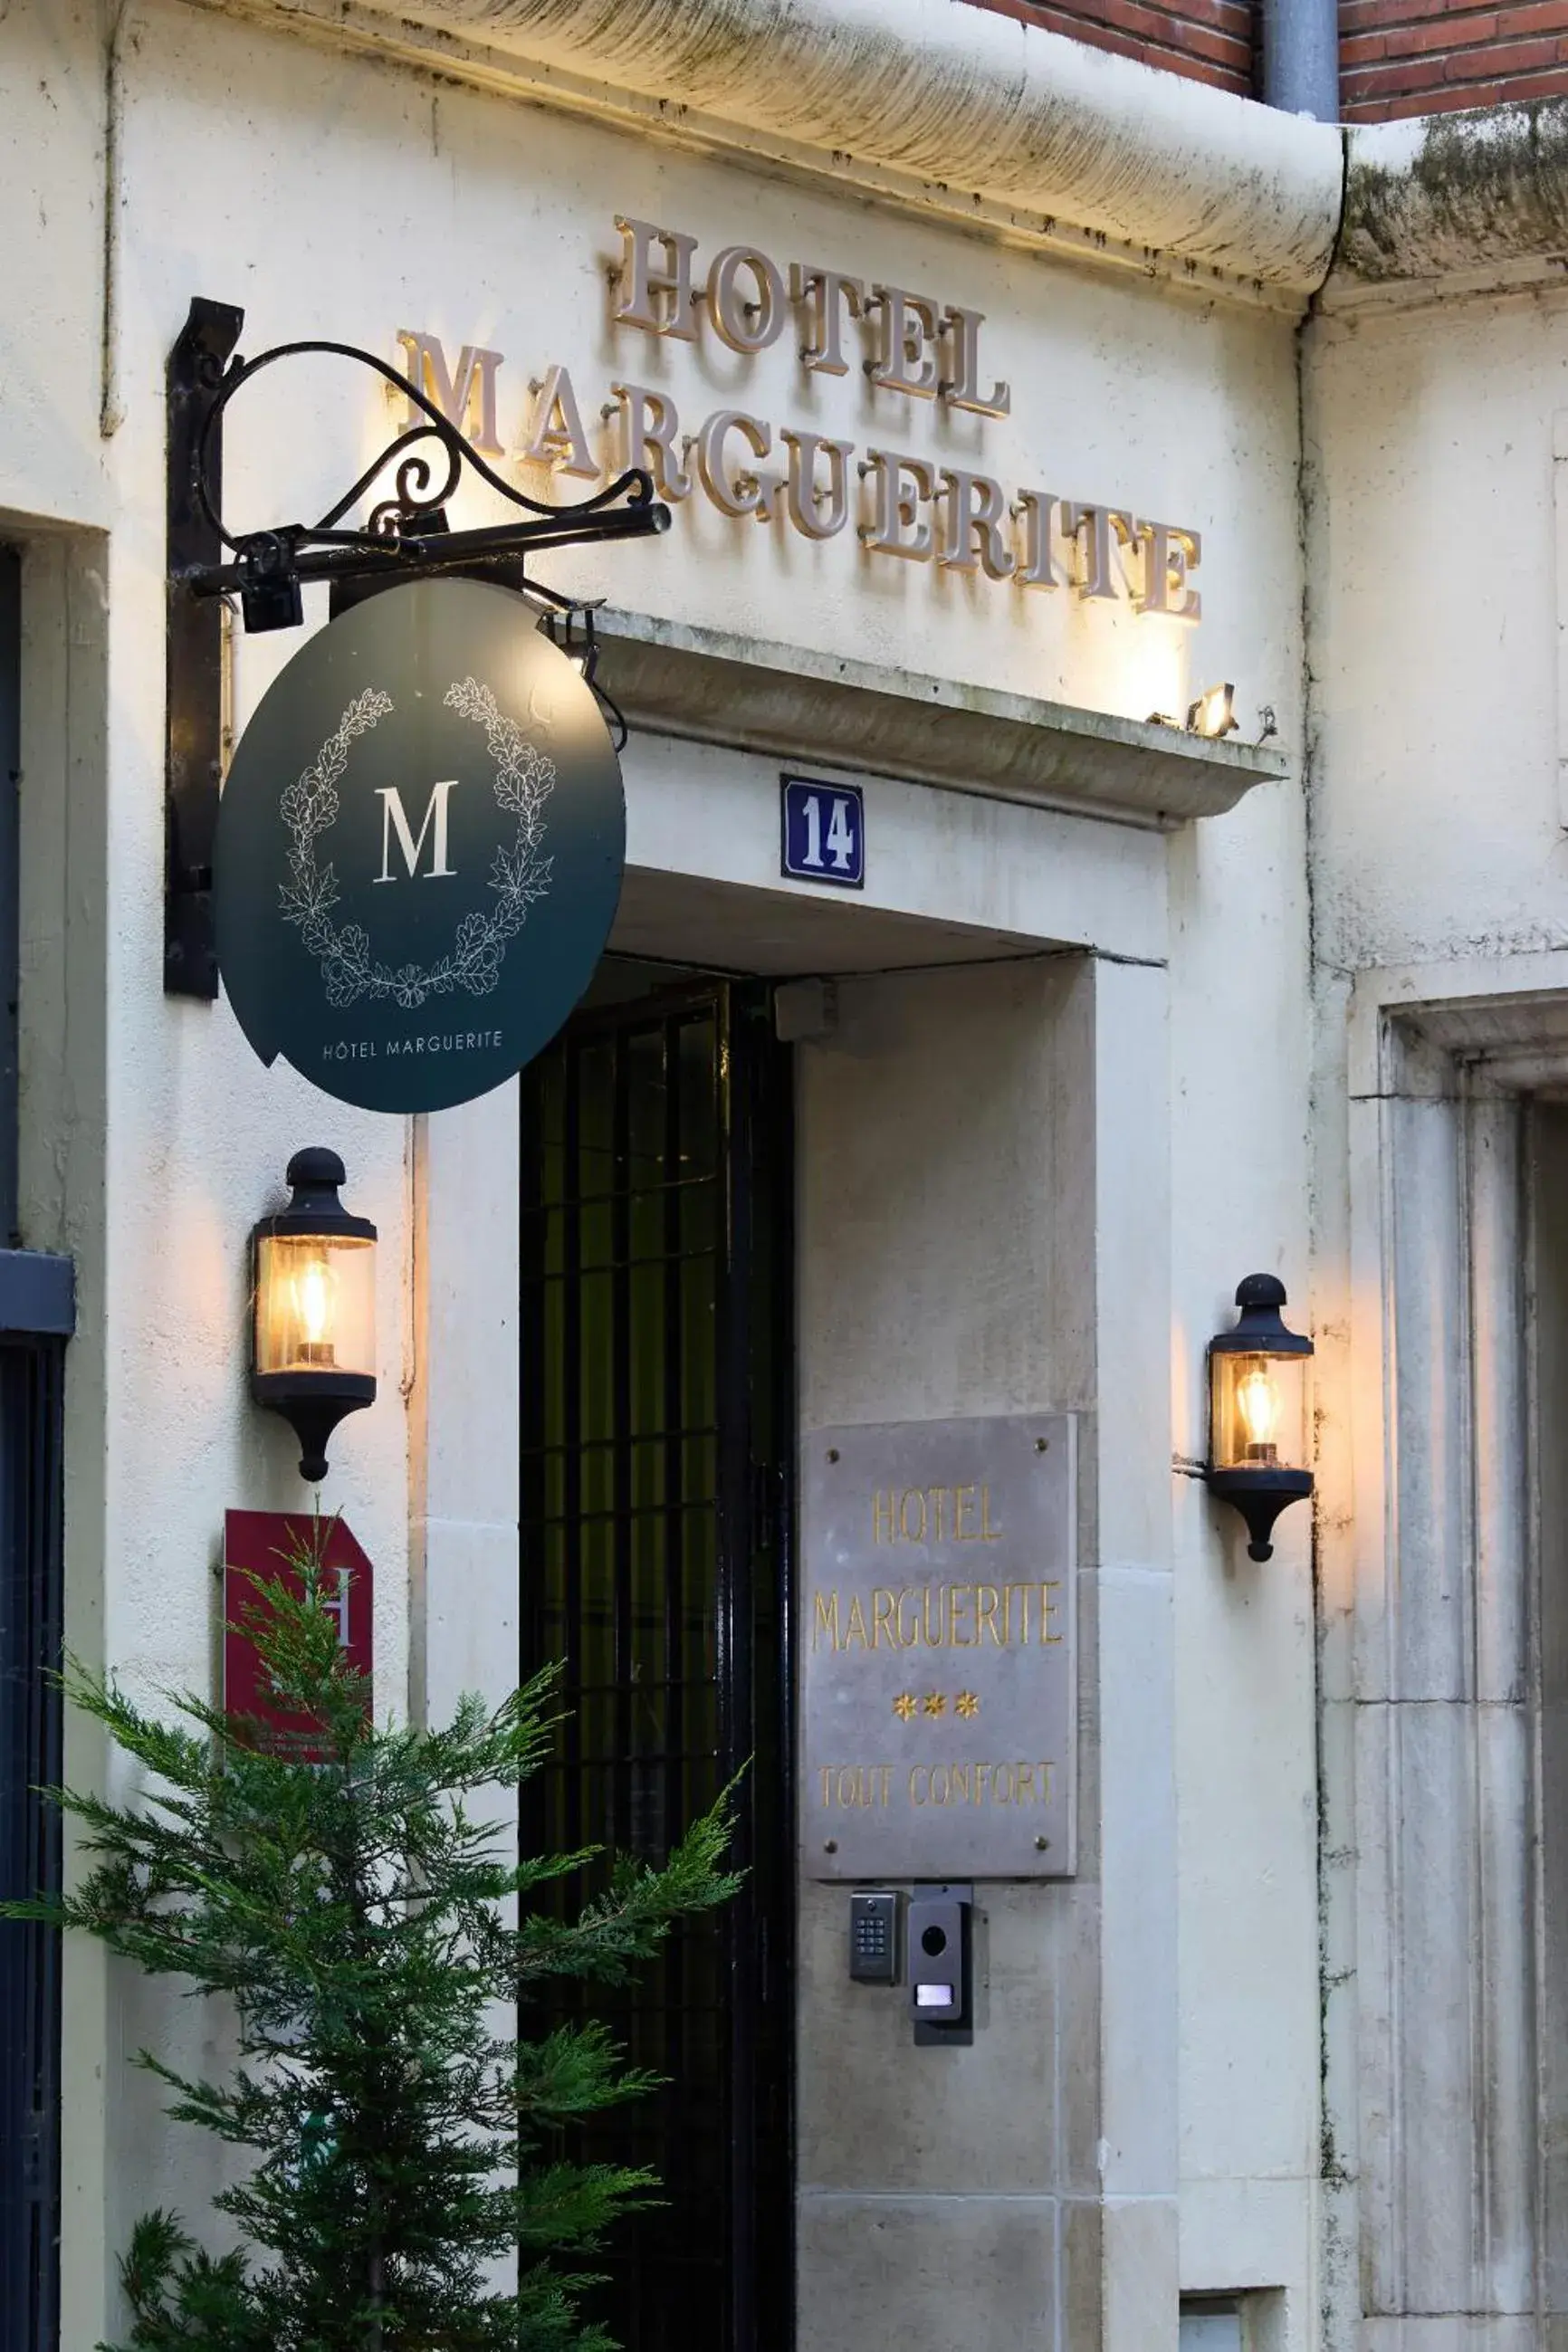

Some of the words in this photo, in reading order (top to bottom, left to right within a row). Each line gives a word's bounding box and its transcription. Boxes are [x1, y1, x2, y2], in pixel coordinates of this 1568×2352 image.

[614, 214, 1010, 419] HOTEL
[396, 328, 1203, 624] MARGUERITE
[372, 780, 459, 884] M
[802, 796, 854, 869] 14
[323, 1041, 378, 1060] HÔTEL
[387, 1030, 502, 1056] MARGUERITE
[872, 1482, 1003, 1544] HOTEL
[813, 1581, 1064, 1653] MARGUERITE
[818, 1764, 894, 1809] TOUT
[909, 1762, 1056, 1807] CONFORT
